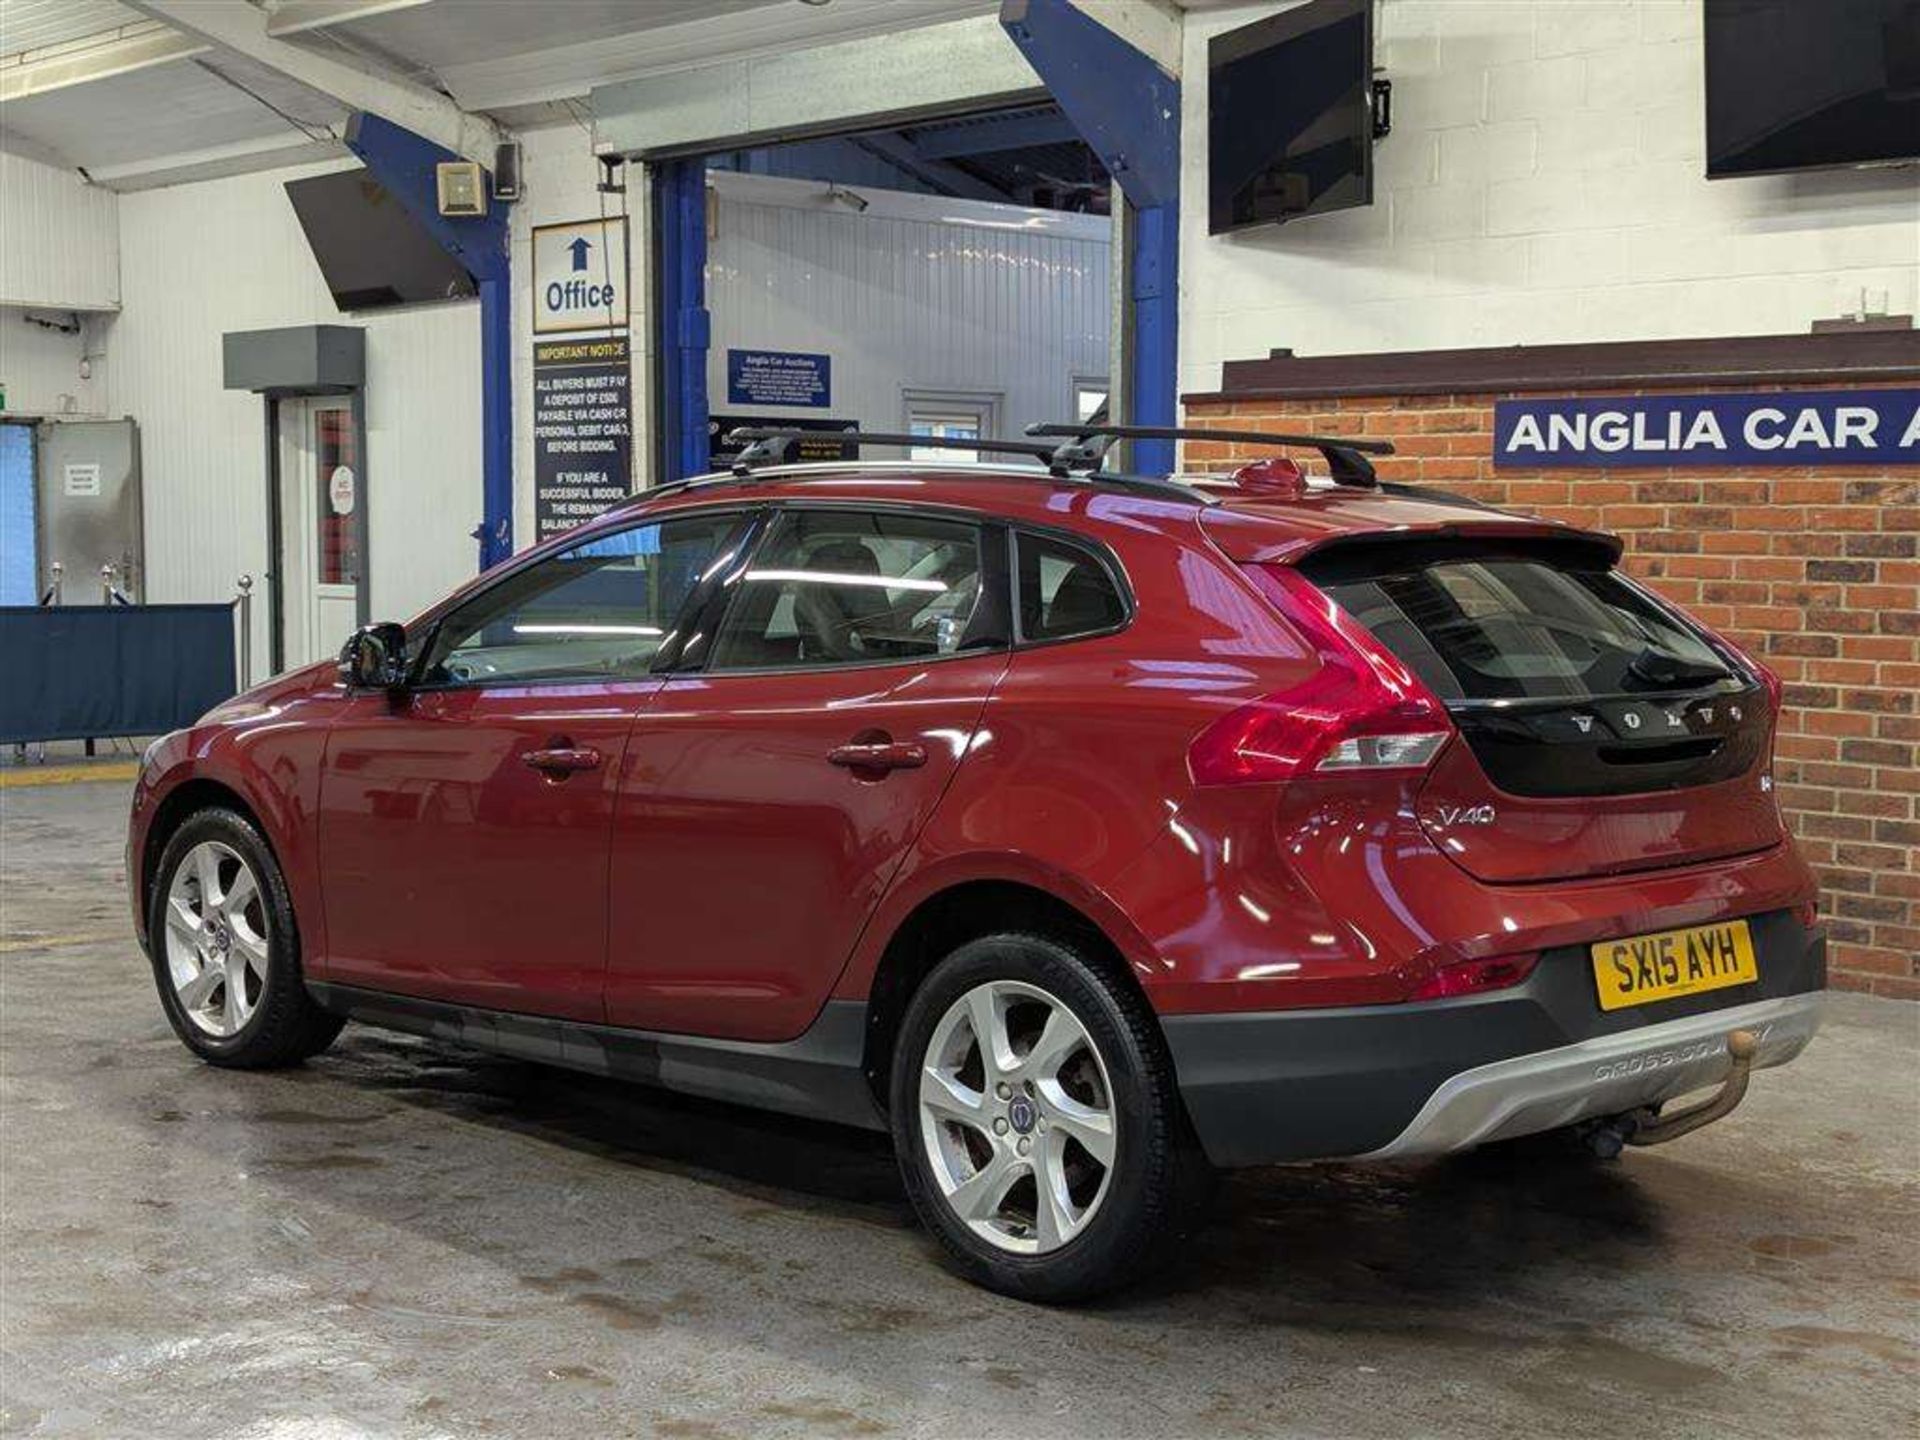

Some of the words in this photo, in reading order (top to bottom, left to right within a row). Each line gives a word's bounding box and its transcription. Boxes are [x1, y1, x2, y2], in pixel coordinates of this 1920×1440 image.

[547, 280, 614, 311] Office
[538, 345, 588, 360] IMPORTANT
[537, 379, 551, 390] ALL
[552, 377, 583, 390] BUYERS
[585, 376, 608, 388] MUST
[543, 395, 550, 406] A
[551, 393, 585, 405] DEPOSIT
[586, 393, 598, 404] OF
[537, 409, 573, 421] PAYABLE
[574, 409, 587, 420] VIA
[588, 408, 612, 420] CASH
[535, 426, 576, 437] PERSONAL
[577, 424, 602, 436] DEBIT
[1506, 410, 1728, 452] ANGLIA
[1744, 407, 1879, 449] CAR
[547, 441, 578, 453] BEFORE
[580, 440, 617, 453] BIDDING.
[556, 472, 564, 483] IF
[564, 472, 582, 483] YOU
[582, 472, 600, 483] ARE
[601, 471, 608, 482] A
[540, 488, 591, 500] SUCCESSFUL
[551, 503, 567, 514] THE
[568, 503, 613, 514] REMAININ
[1571, 705, 1742, 732] VOLVO
[1436, 804, 1495, 825] V40
[1611, 937, 1679, 993] SX15
[1685, 927, 1739, 980] AYH
[1681, 1024, 1773, 1063] COUY
